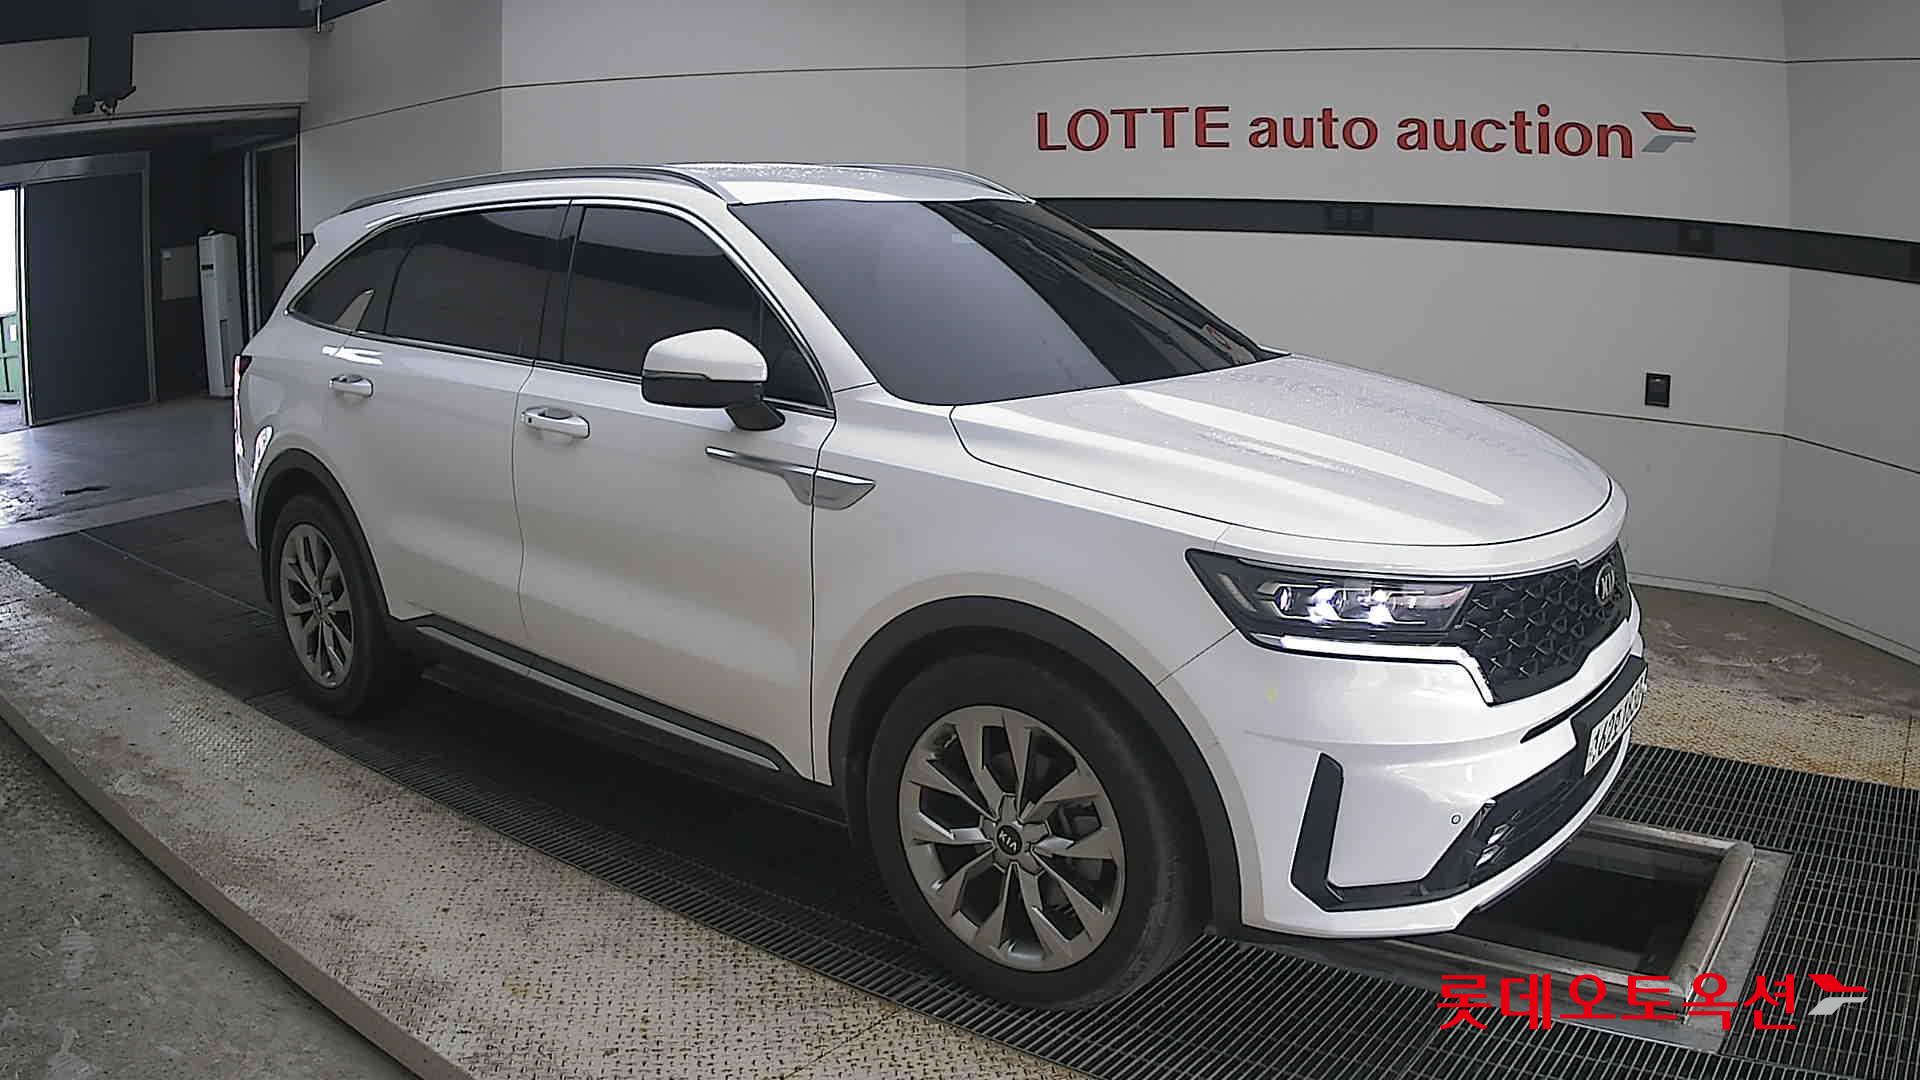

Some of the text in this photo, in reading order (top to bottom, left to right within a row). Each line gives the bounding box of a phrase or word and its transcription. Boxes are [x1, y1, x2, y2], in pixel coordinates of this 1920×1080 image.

[1037, 103, 1634, 160] LOTTE auto auction
[998, 829, 1018, 852] KIA
